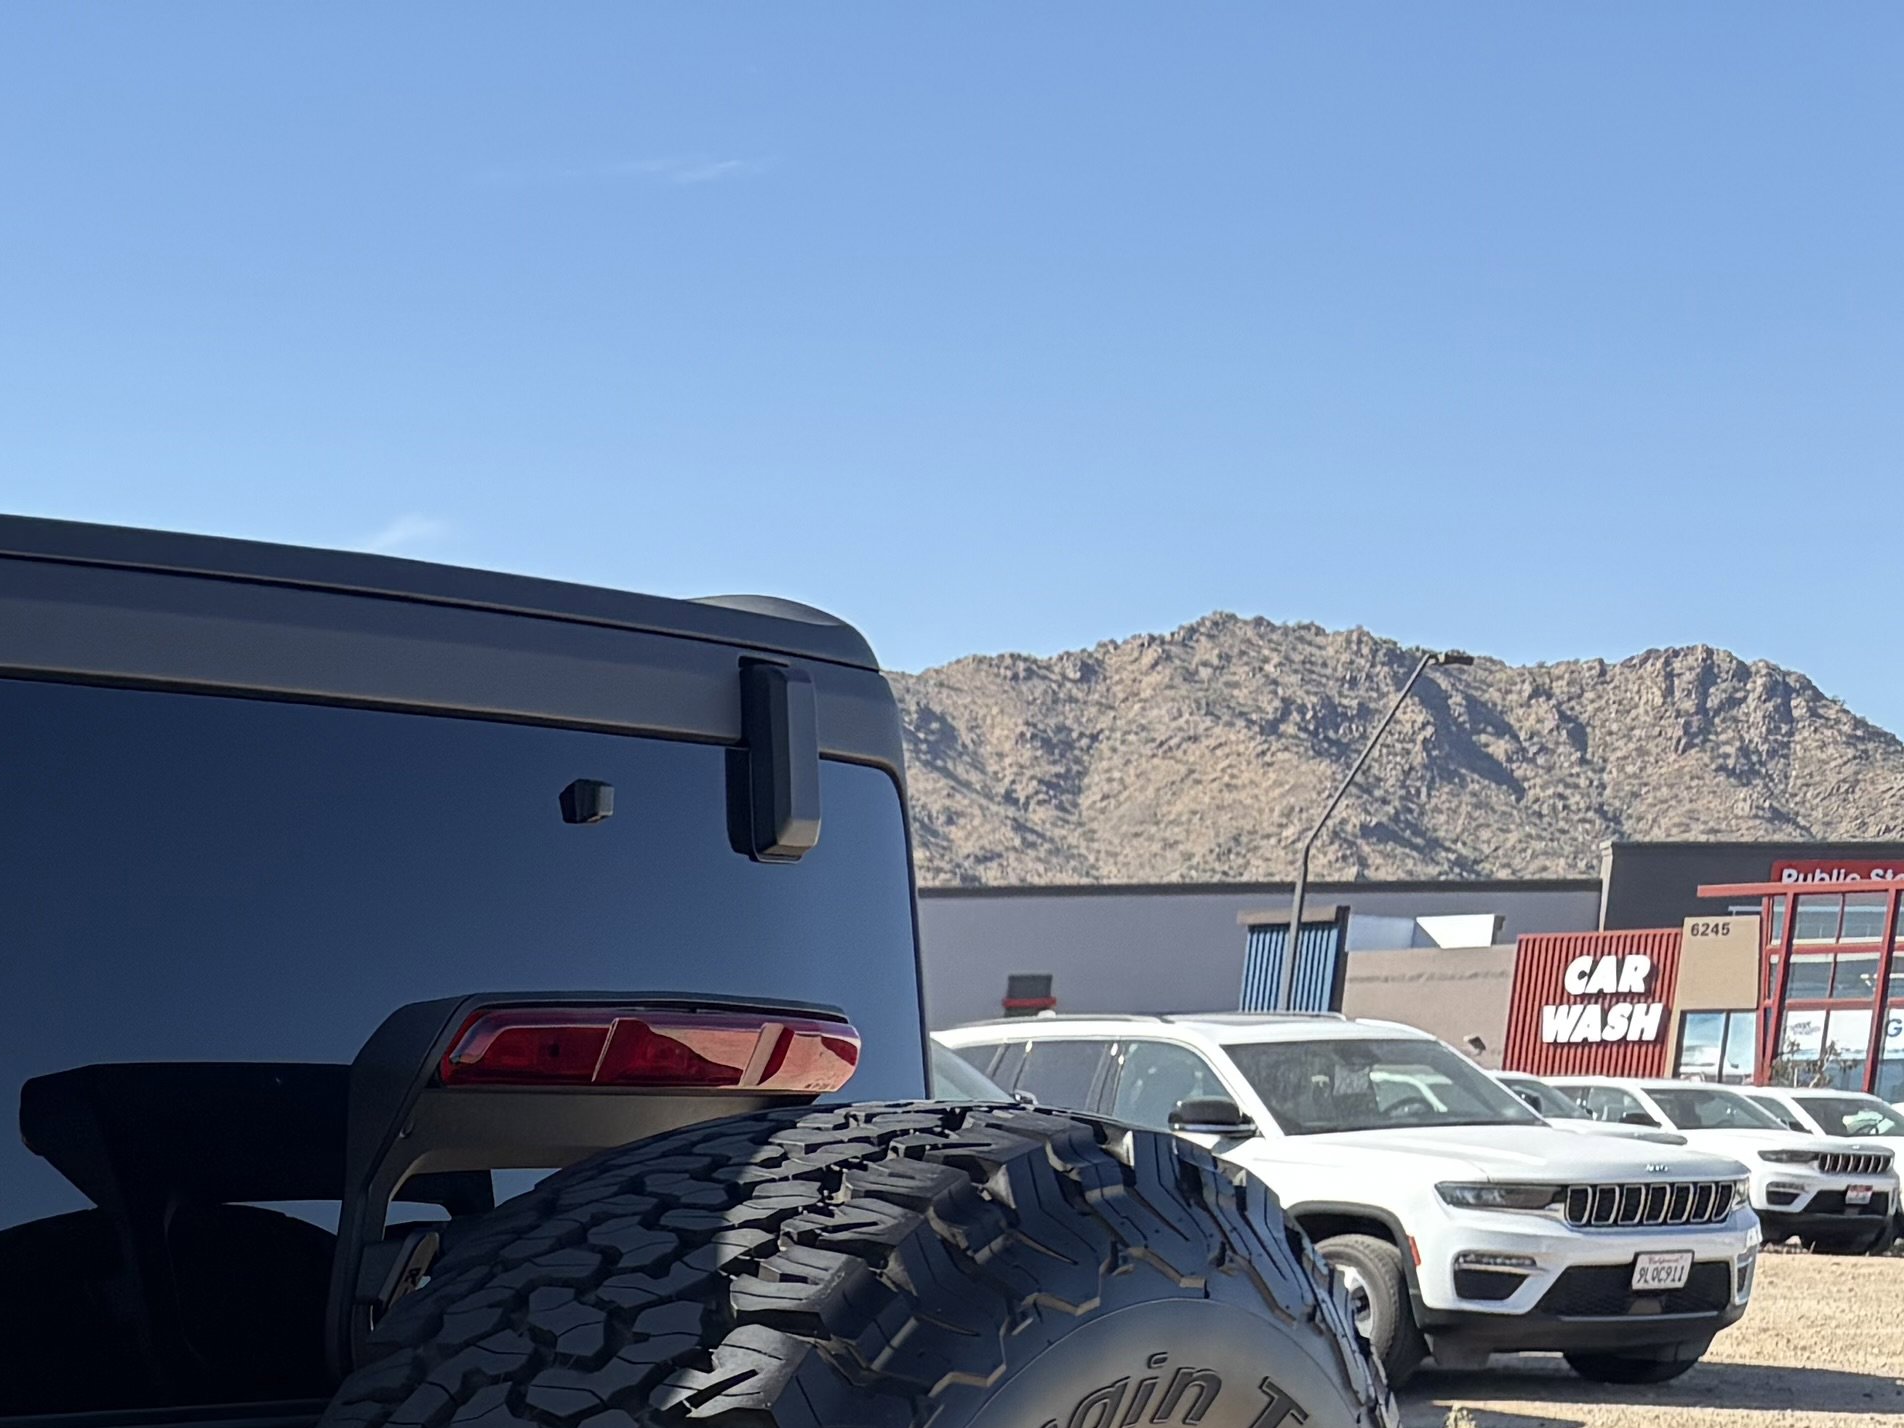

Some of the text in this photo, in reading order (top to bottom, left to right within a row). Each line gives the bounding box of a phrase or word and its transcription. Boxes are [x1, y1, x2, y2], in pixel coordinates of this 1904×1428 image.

[1690, 922, 1731, 938] 6245
[1563, 953, 1652, 996] CAR
[1541, 1002, 1664, 1044] WASH
